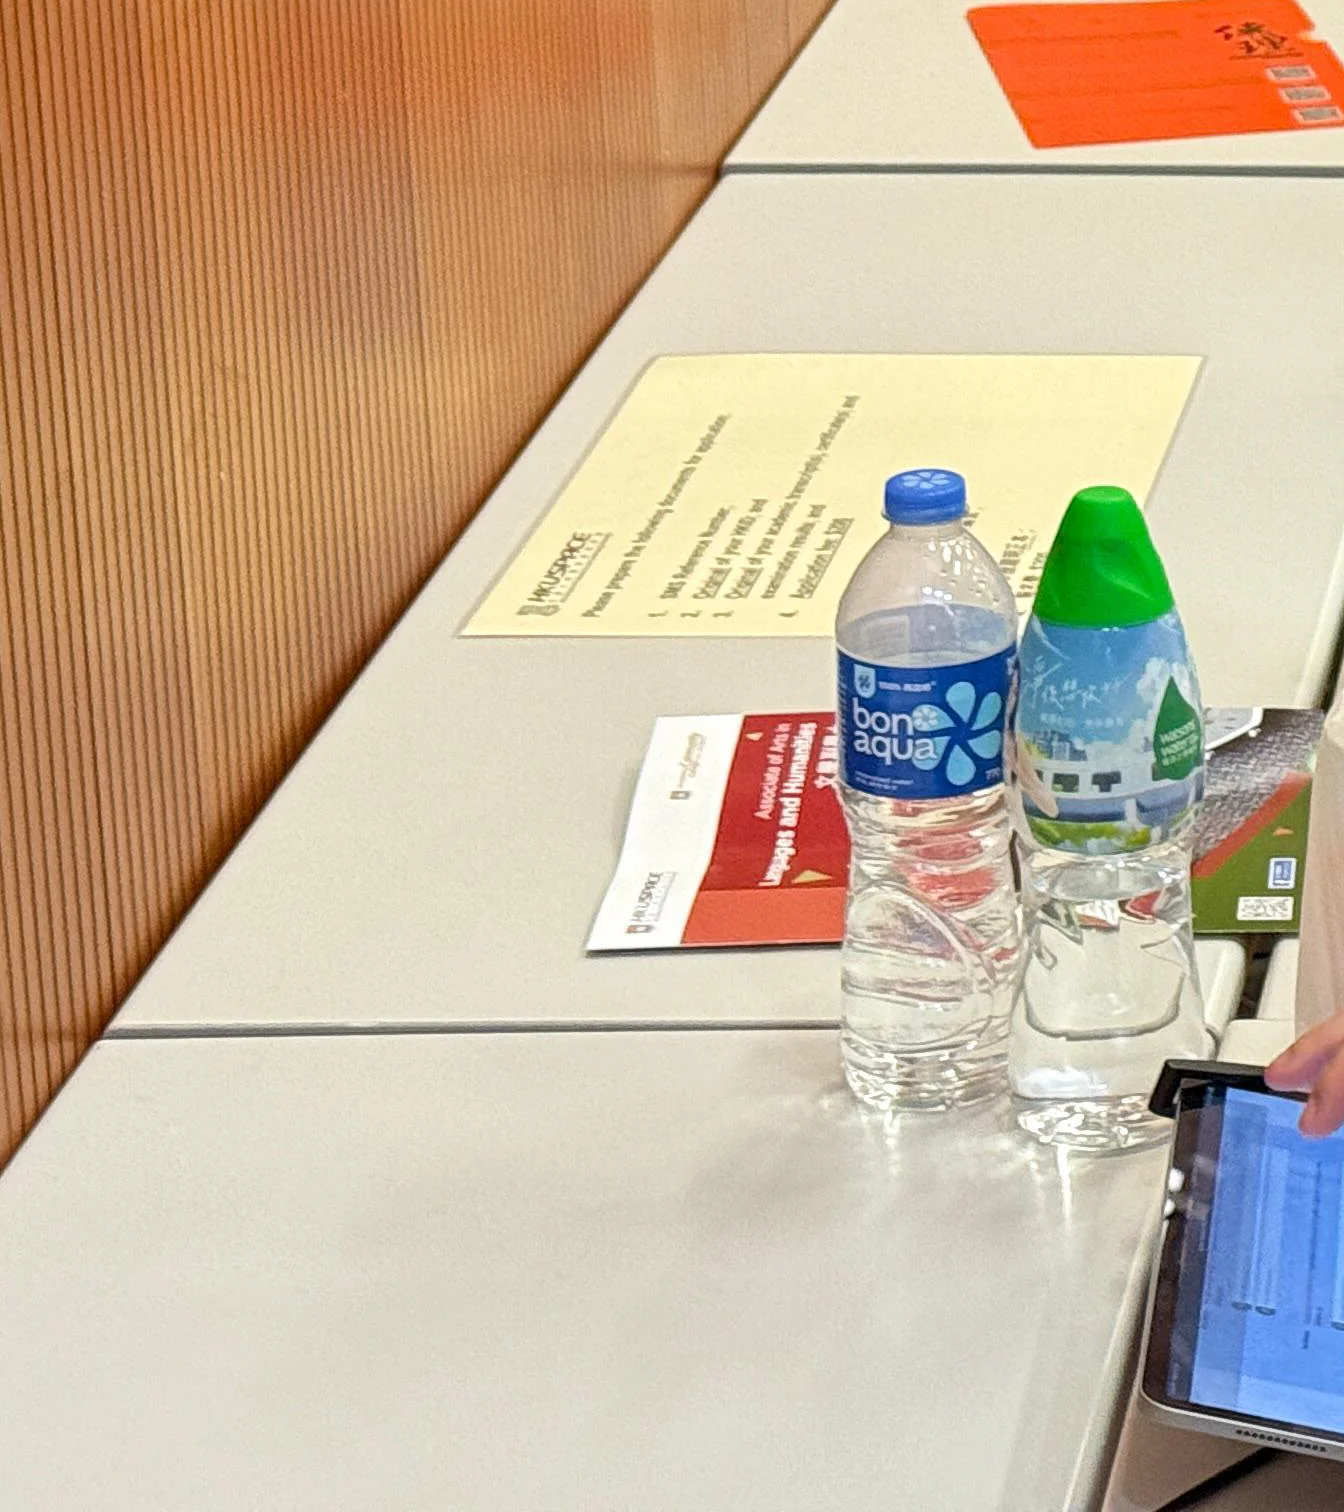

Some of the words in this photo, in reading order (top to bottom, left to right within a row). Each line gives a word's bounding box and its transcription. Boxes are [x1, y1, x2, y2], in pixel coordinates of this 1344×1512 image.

[775, 723, 792, 732] in
[853, 697, 914, 736] bon
[769, 733, 790, 753] Arts
[780, 722, 817, 794] Humanities
[853, 730, 939, 765] aqua
[767, 754, 784, 765] of
[754, 766, 781, 820] Associate
[778, 797, 801, 827] and
